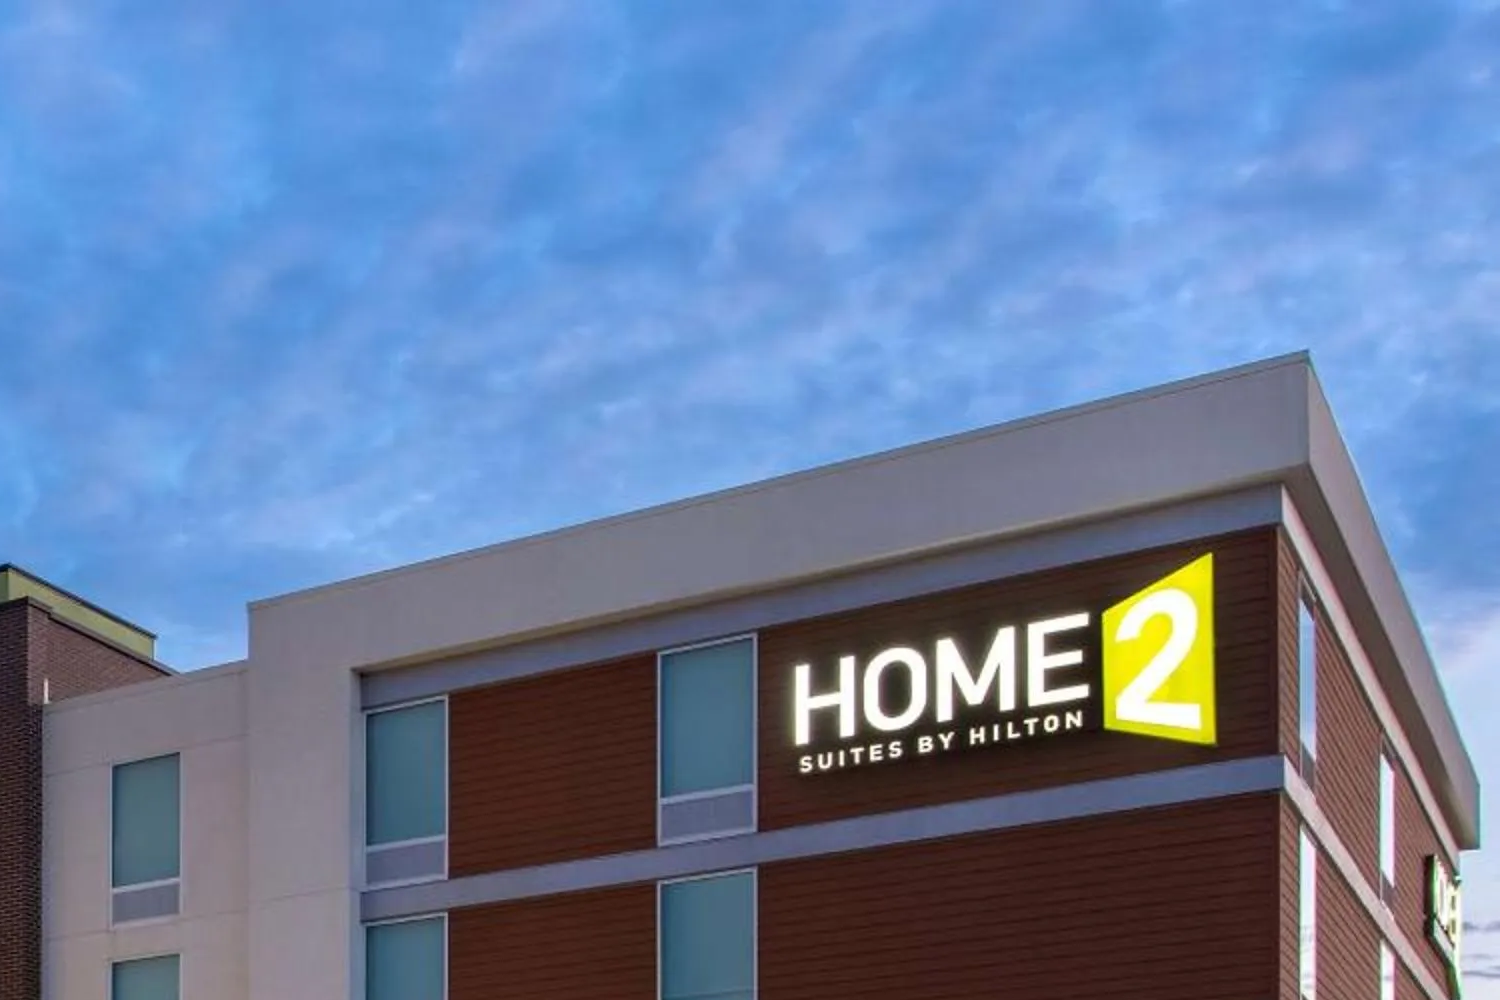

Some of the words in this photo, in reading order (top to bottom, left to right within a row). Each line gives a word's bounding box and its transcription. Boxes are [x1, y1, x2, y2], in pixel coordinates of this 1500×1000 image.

[794, 612, 1090, 746] HOME
[1115, 588, 1202, 730] 2
[799, 741, 904, 773] SUITES
[918, 730, 956, 754] BY
[969, 710, 1084, 746] HILTON
